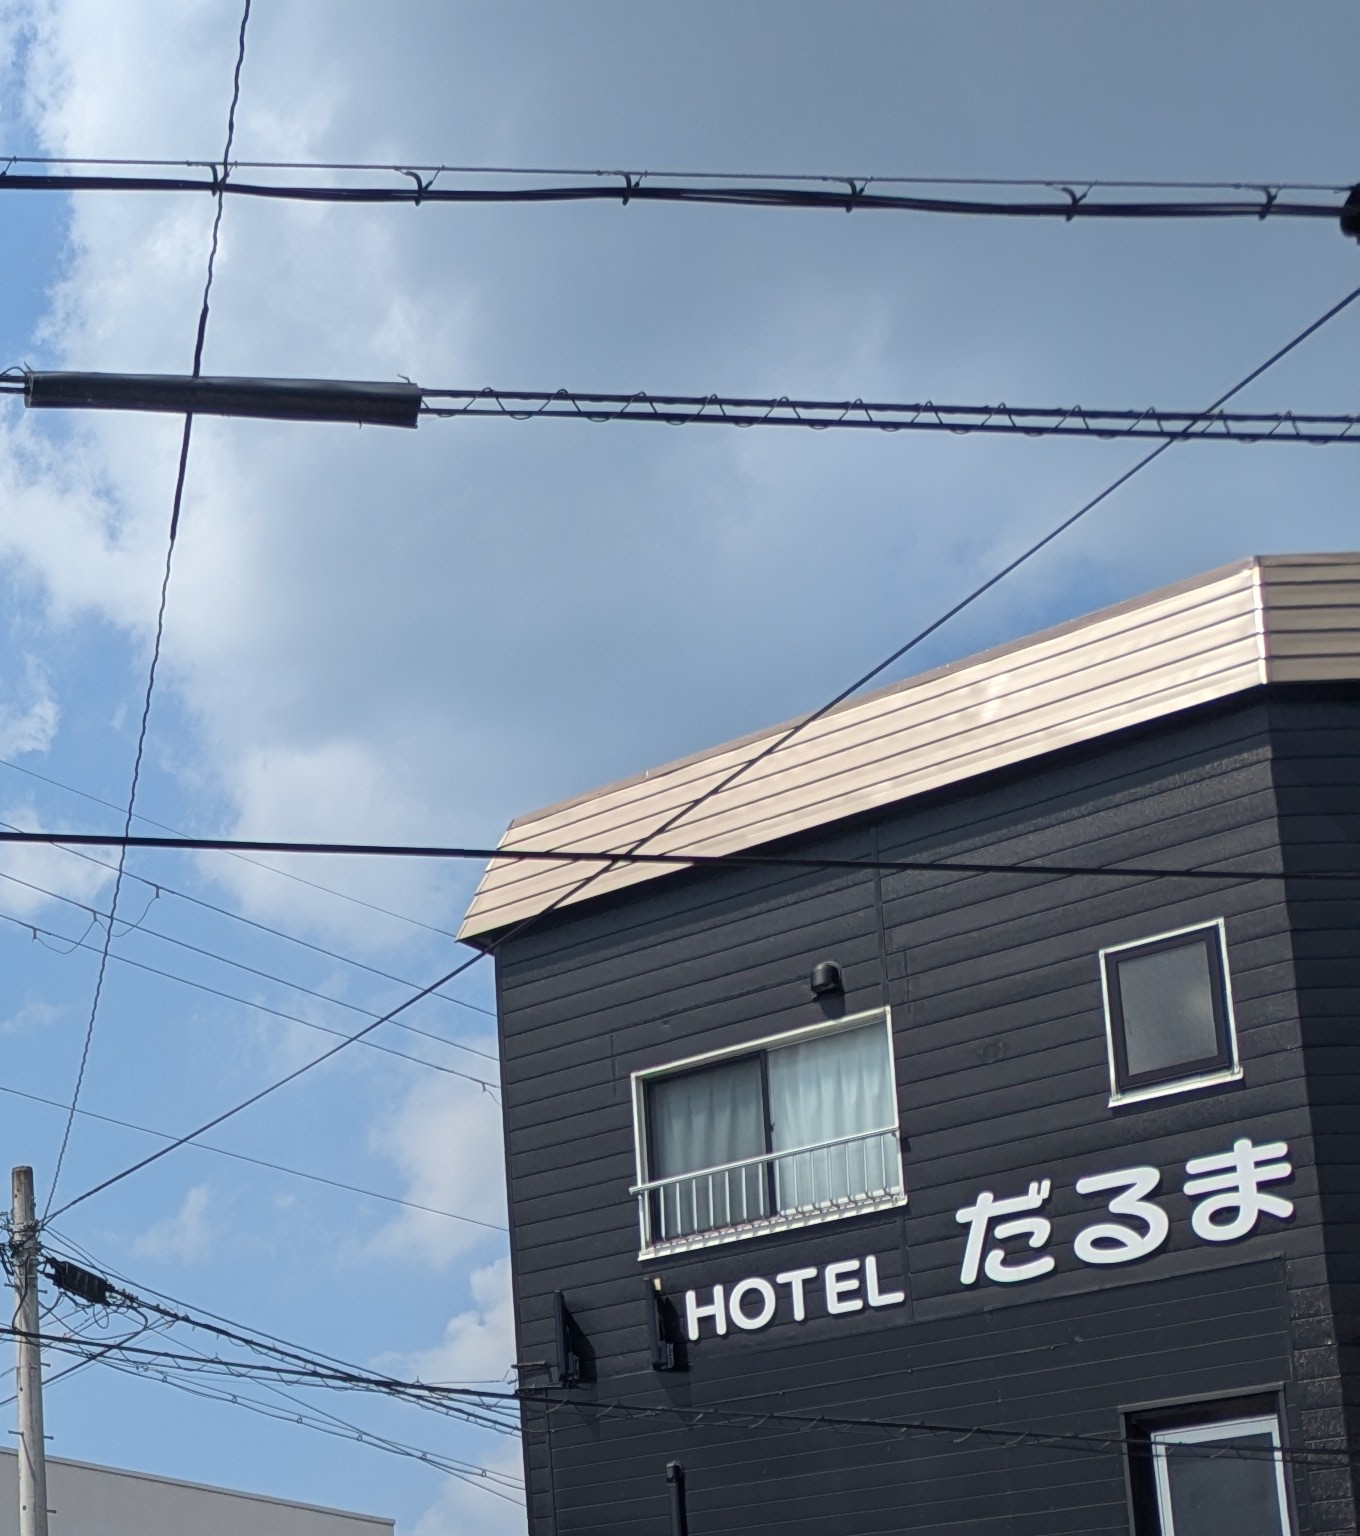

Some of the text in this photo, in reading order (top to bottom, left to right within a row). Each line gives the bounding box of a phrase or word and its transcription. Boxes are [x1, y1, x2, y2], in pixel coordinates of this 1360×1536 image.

[684, 1137, 1295, 1341] HOTEL だるま
